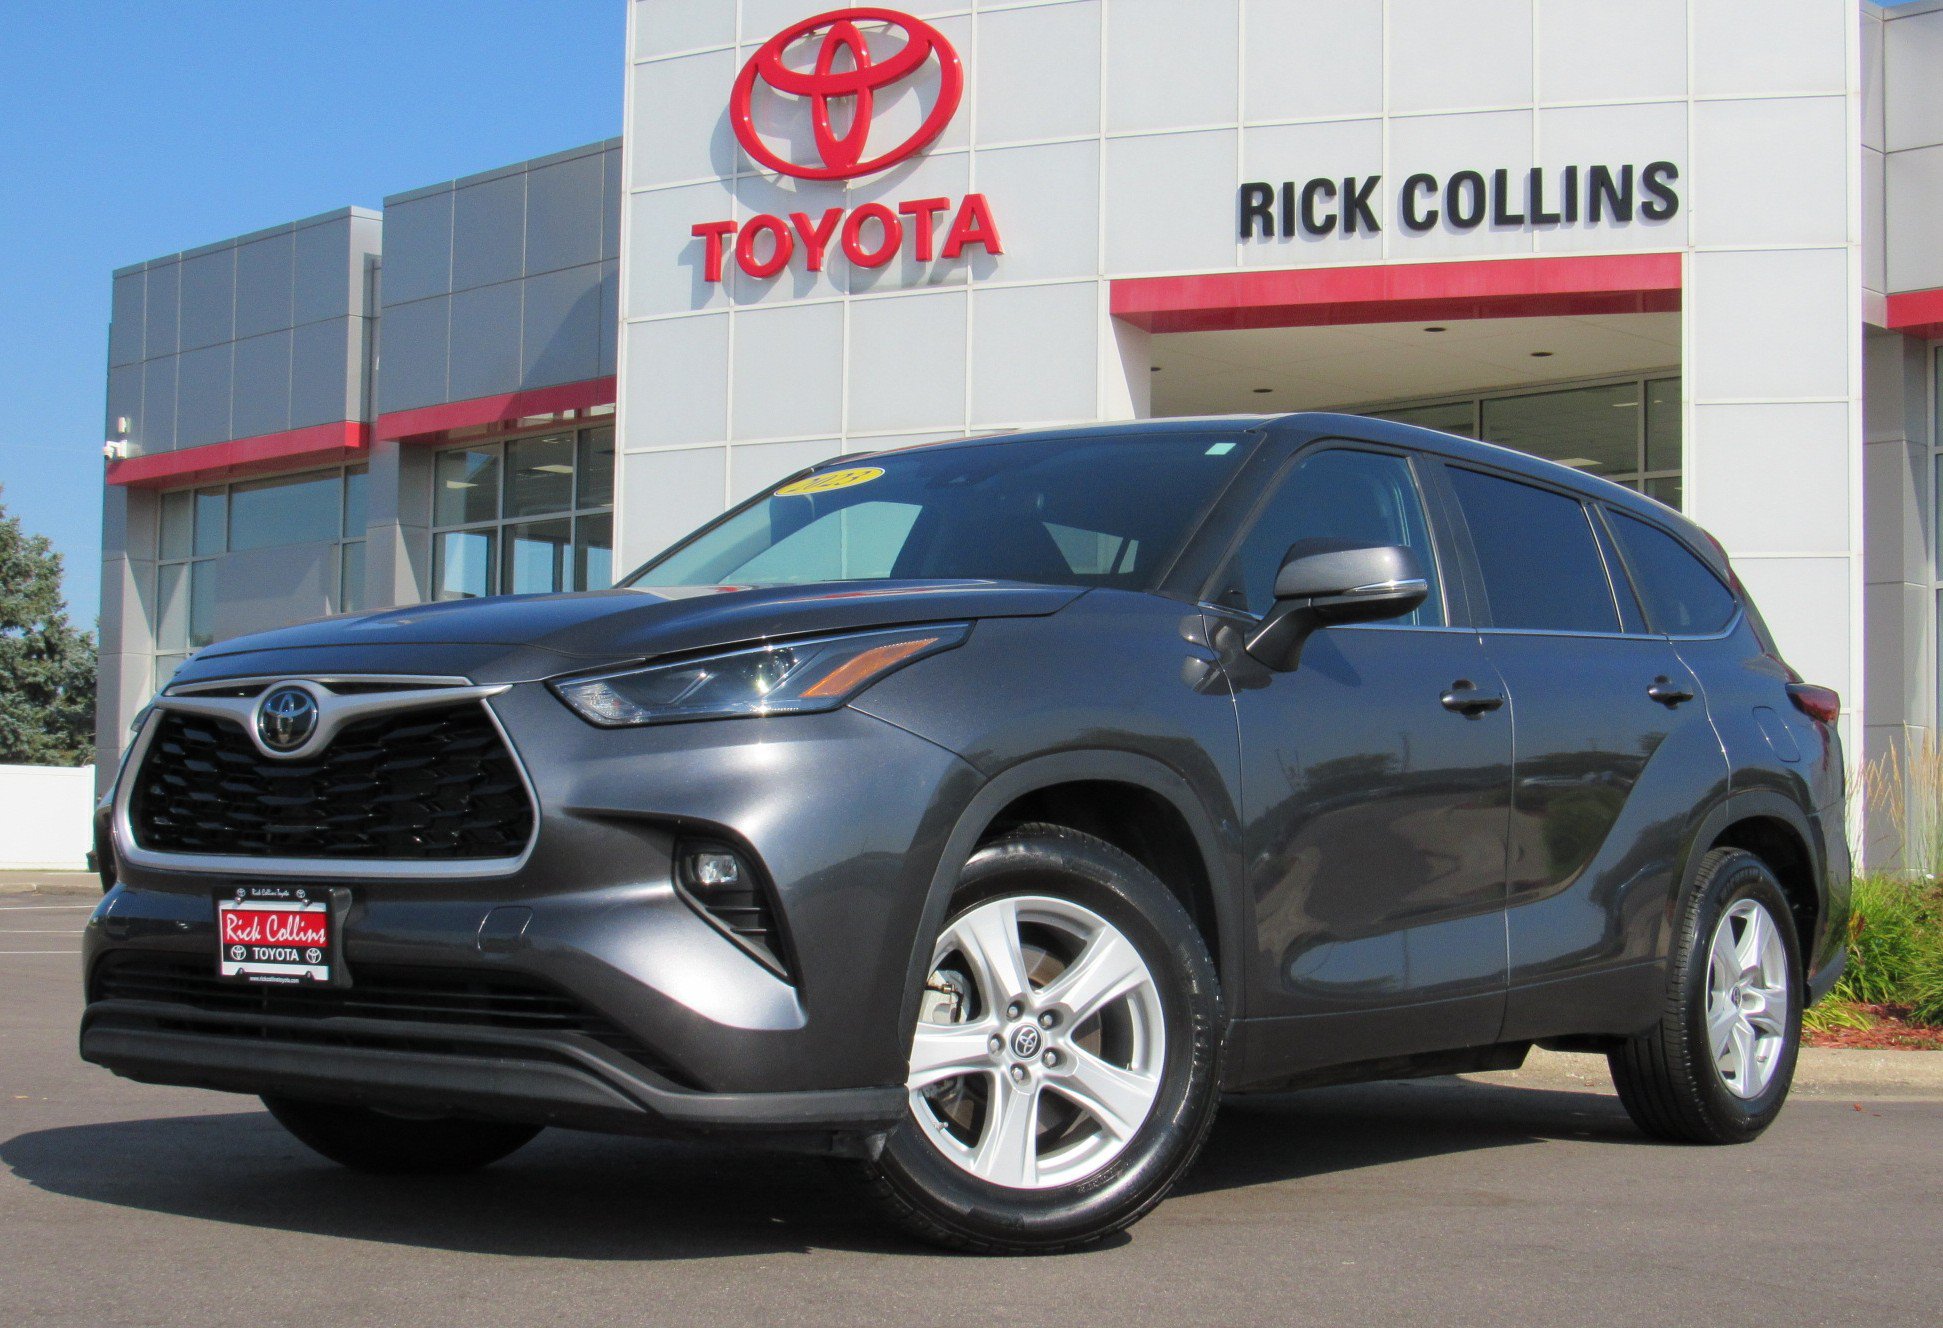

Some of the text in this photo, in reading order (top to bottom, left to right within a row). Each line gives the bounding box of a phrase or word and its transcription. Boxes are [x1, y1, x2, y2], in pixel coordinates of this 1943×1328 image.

[1240, 161, 1679, 238] RICK COLLINS
[692, 193, 1004, 282] TOYOTA
[226, 913, 326, 944] Rick Collins
[252, 947, 300, 961] TOYOTA
